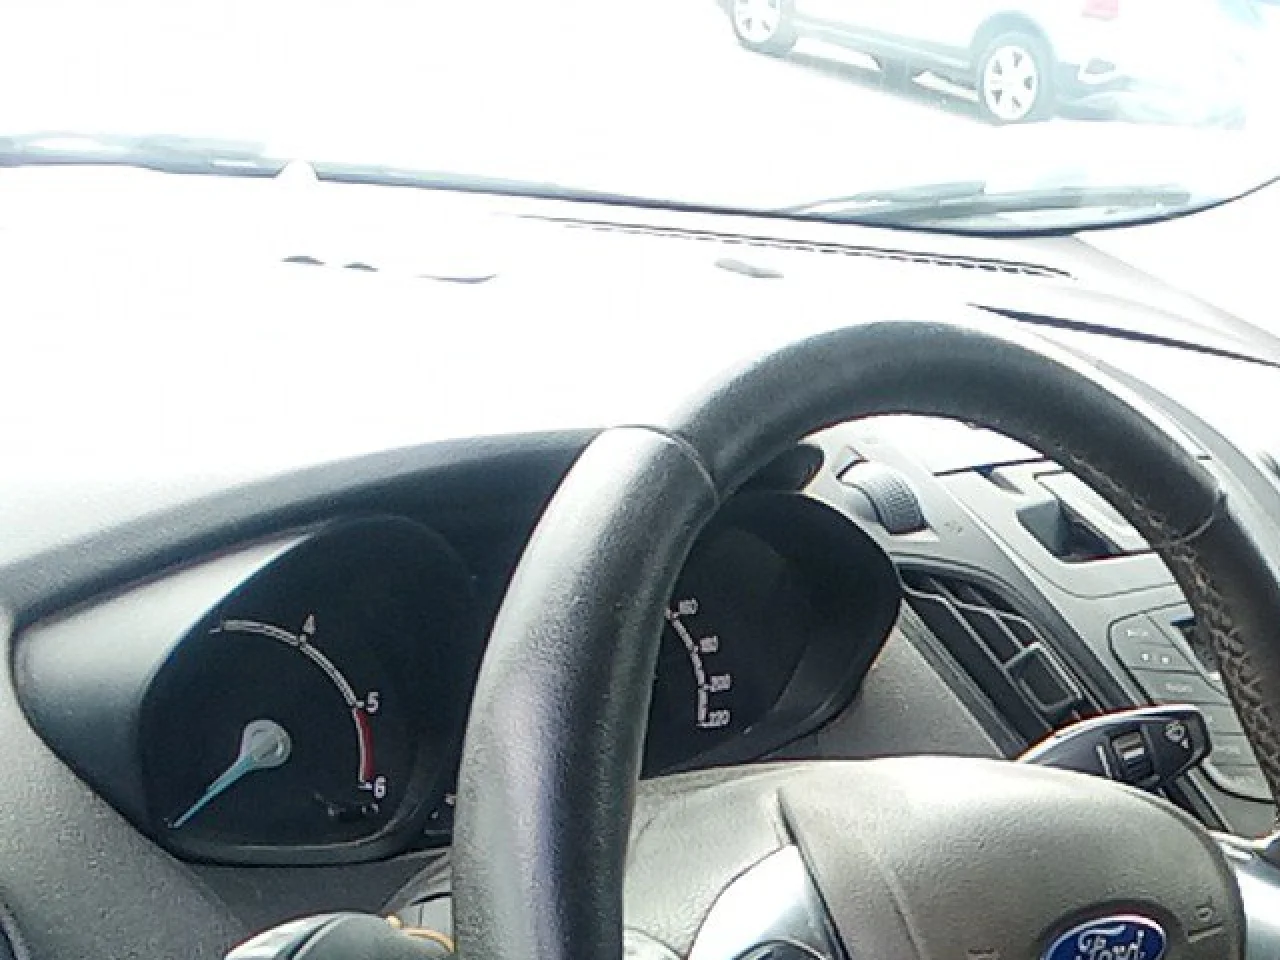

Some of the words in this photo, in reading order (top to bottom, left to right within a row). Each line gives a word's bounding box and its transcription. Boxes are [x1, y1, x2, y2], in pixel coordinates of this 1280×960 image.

[302, 614, 316, 635] 4
[366, 691, 379, 713] 5
[373, 775, 387, 799] 6
